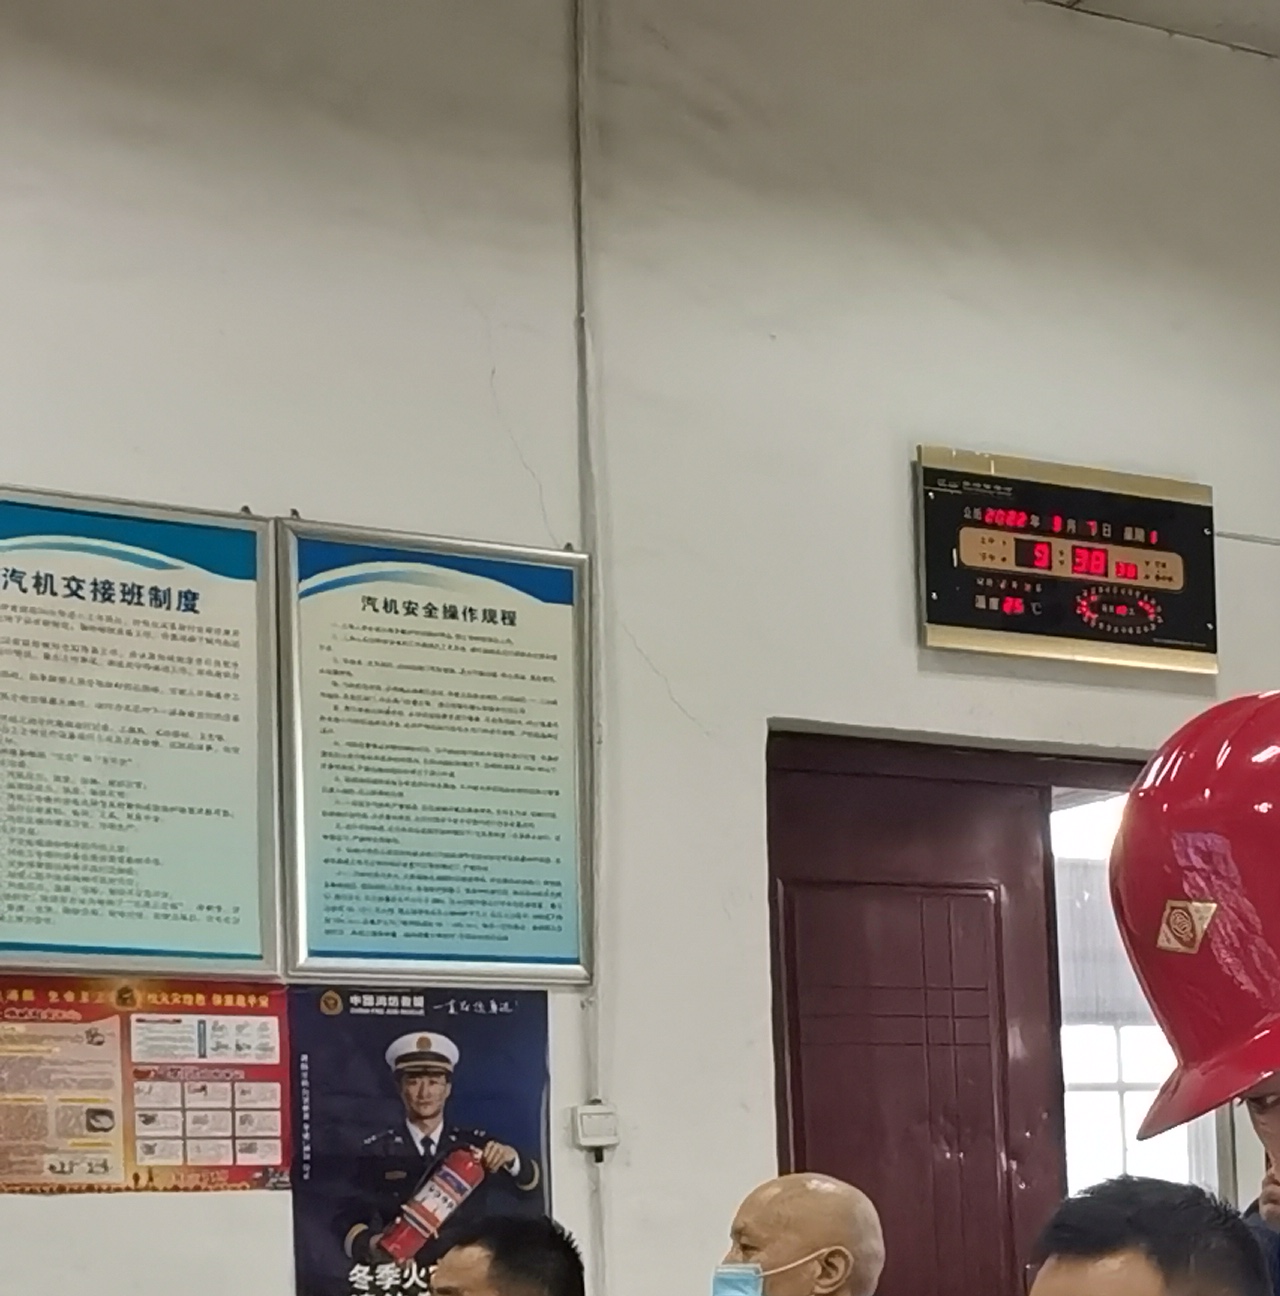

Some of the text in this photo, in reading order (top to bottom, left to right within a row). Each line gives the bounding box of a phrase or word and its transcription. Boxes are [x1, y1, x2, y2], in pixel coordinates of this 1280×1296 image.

[0, 566, 201, 616] 汽机交接班制度
[360, 594, 519, 628] 汽机安全操作规程
[348, 1262, 438, 1291] 冬季火
